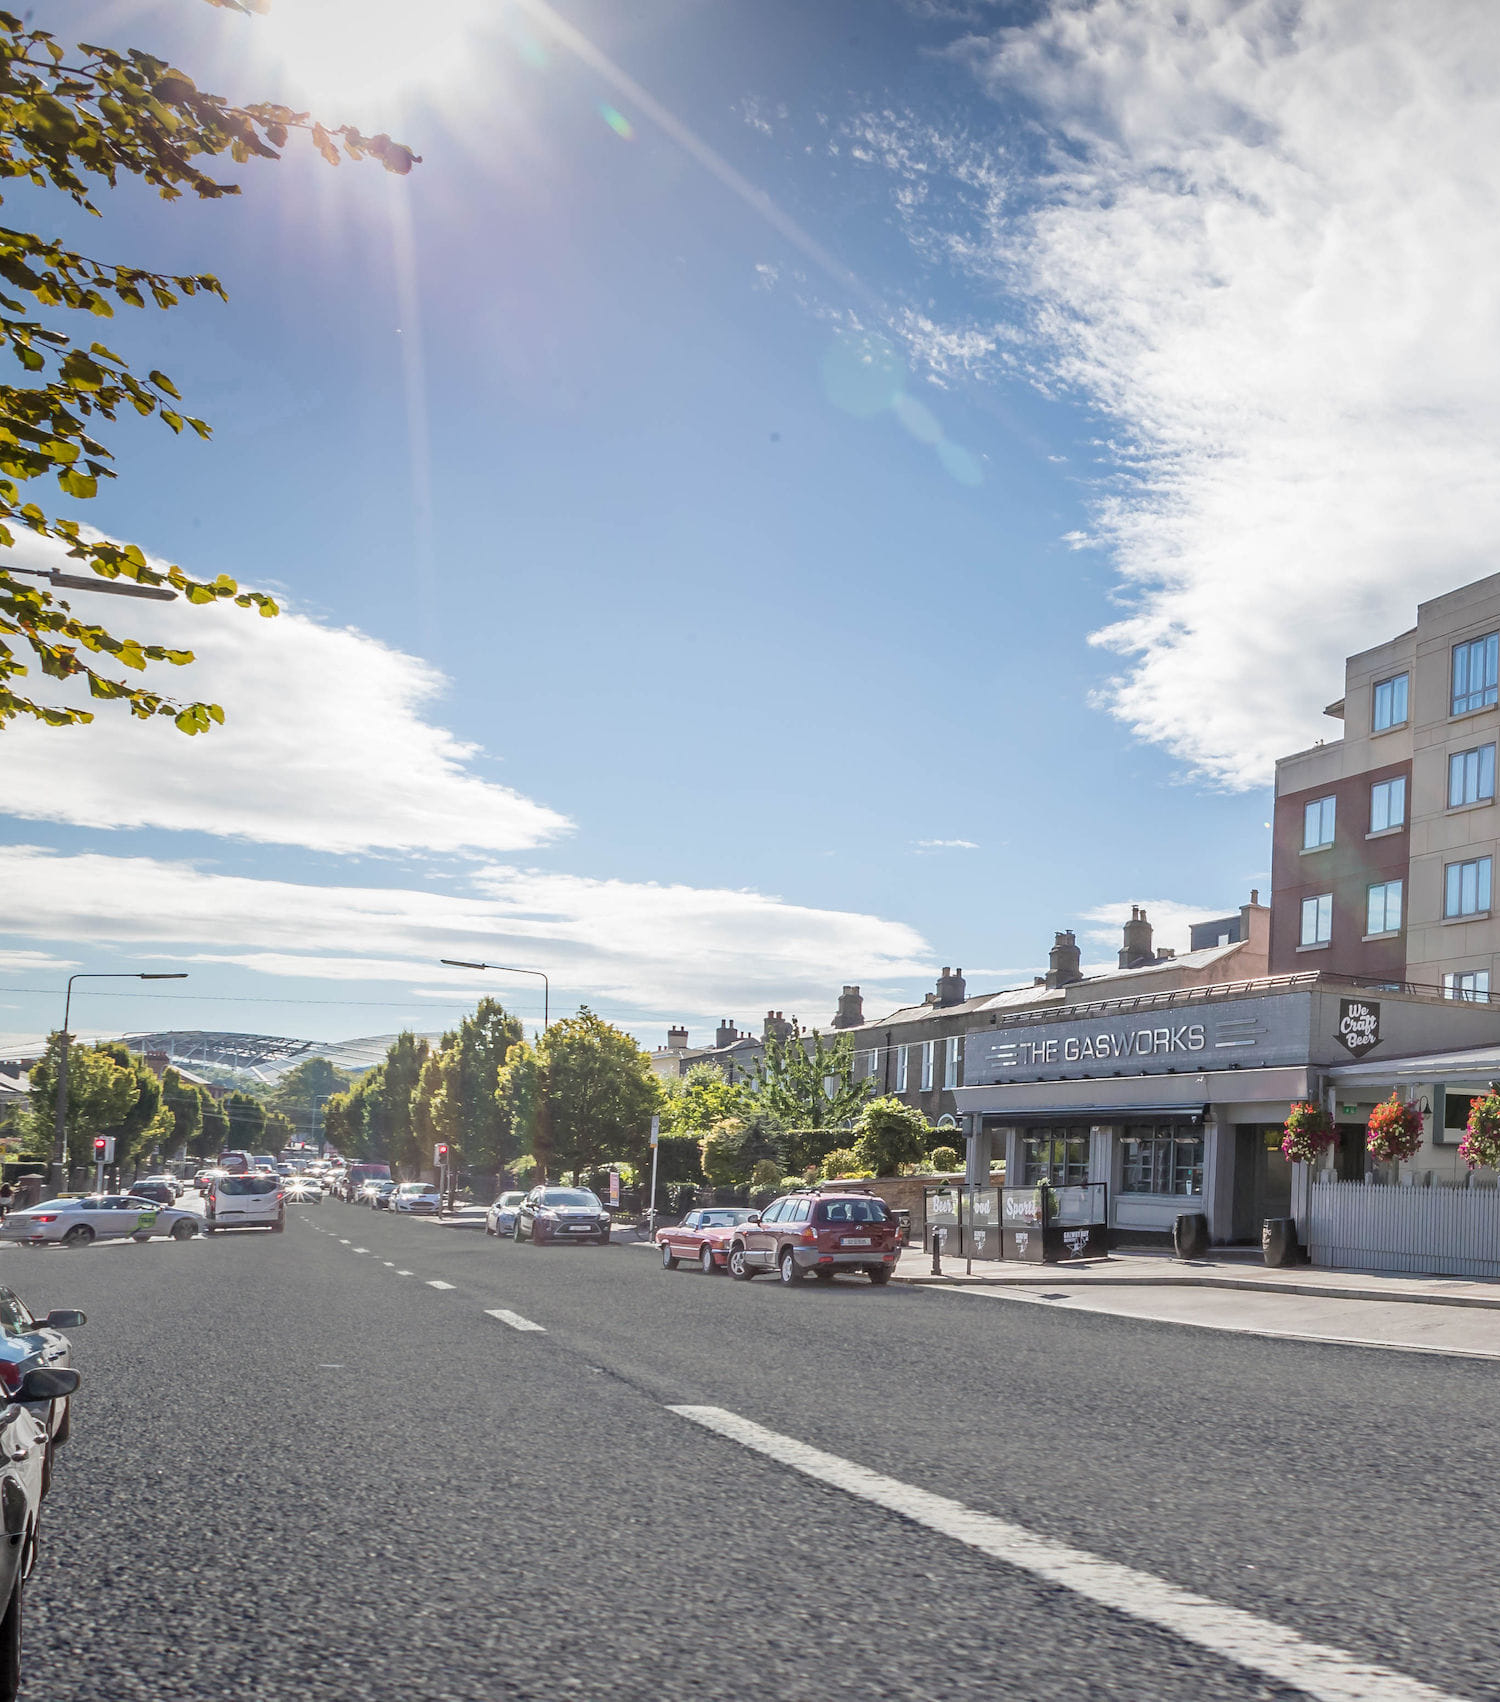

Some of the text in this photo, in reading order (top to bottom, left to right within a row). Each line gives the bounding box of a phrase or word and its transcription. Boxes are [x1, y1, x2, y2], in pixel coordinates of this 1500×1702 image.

[1348, 1003, 1370, 1018] We
[1340, 1014, 1378, 1036] Craft
[1020, 1024, 1206, 1065] THE GASWORKS
[1345, 1032, 1377, 1048] Beer
[973, 1197, 992, 1214] ood
